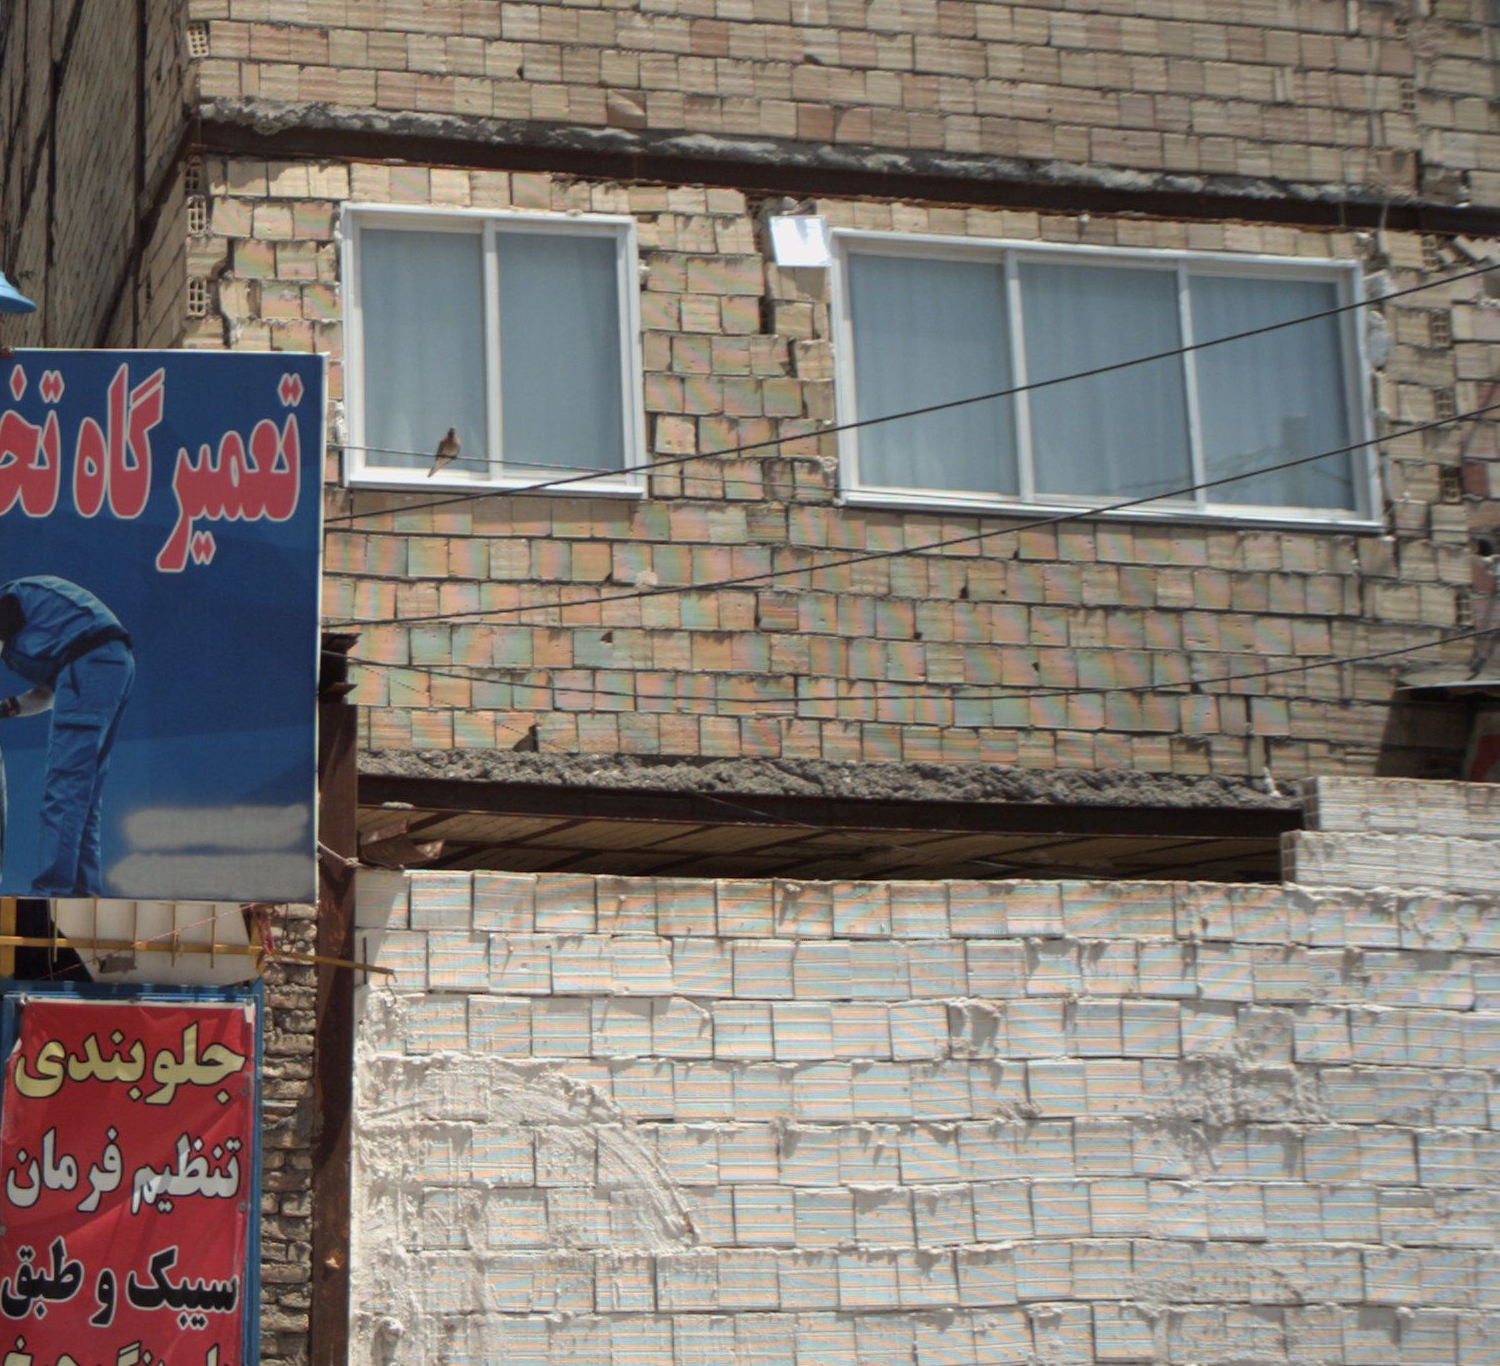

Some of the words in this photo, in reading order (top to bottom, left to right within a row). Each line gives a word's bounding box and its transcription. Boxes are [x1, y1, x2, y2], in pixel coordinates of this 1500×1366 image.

[73, 363, 165, 518] گاه
[156, 373, 304, 572] تعمیر
[15, 1020, 246, 1105] جلوبندی
[6, 1126, 123, 1212] فرمان
[131, 1132, 242, 1215] تنظیم
[0, 1235, 84, 1320] طبق
[89, 1268, 117, 1327] و
[126, 1245, 239, 1330] سیبک
